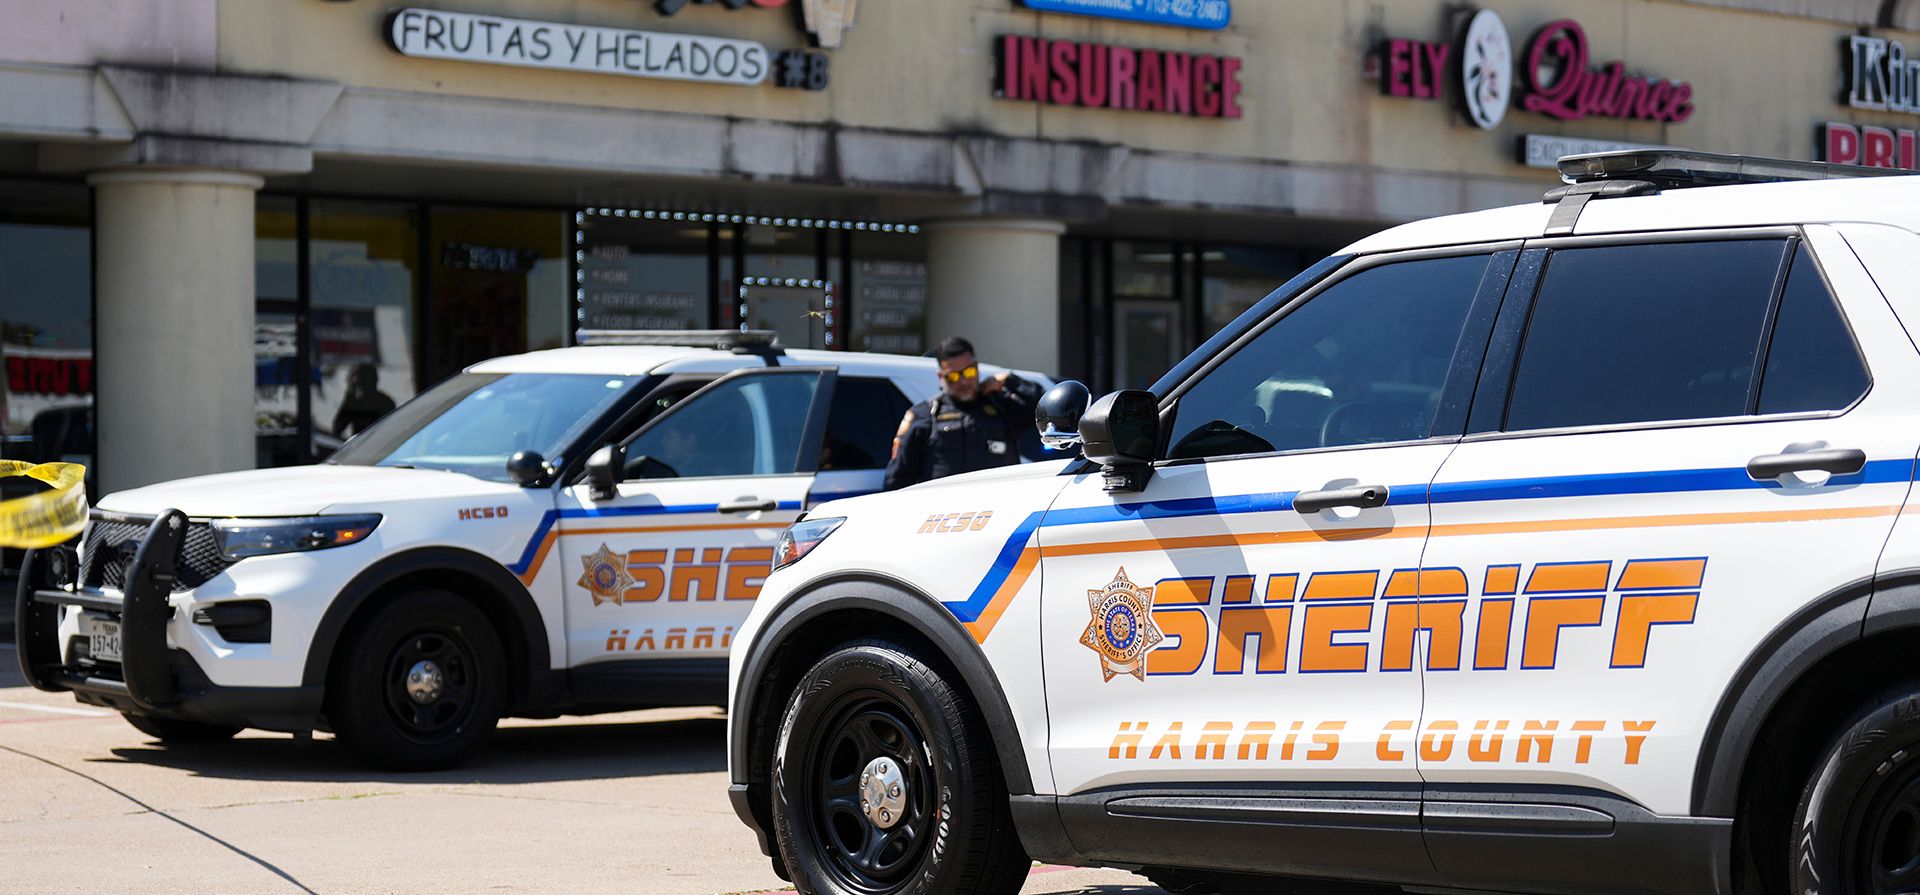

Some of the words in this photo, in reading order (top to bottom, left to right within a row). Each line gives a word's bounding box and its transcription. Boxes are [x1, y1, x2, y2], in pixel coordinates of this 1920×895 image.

[401, 13, 551, 60] FRUTAS
[564, 29, 586, 63] Y
[595, 32, 762, 79] HELADOS
[786, 51, 828, 90] #8
[1003, 34, 1242, 118] INSURANCE
[1390, 38, 1451, 100] ELY
[1524, 18, 1694, 122] Quince
[457, 506, 508, 520] HCSO
[916, 510, 993, 534] HCSO
[622, 546, 775, 603] SHE
[1108, 582, 1133, 592] SHERIFF
[1099, 595, 1118, 620] HARRIS
[1118, 594, 1142, 618] COUNTY
[1108, 606, 1120, 619] STATE
[1127, 610, 1135, 632] TEXAS
[1146, 556, 1709, 676] SHERIFF
[102, 624, 118, 633] TEXAS
[605, 626, 733, 651] HARRI
[1099, 634, 1127, 660] SHERIFF'S
[1126, 633, 1142, 657] OFFICE
[1108, 719, 1347, 761] HARRIS
[1375, 719, 1657, 765] COUNTY
